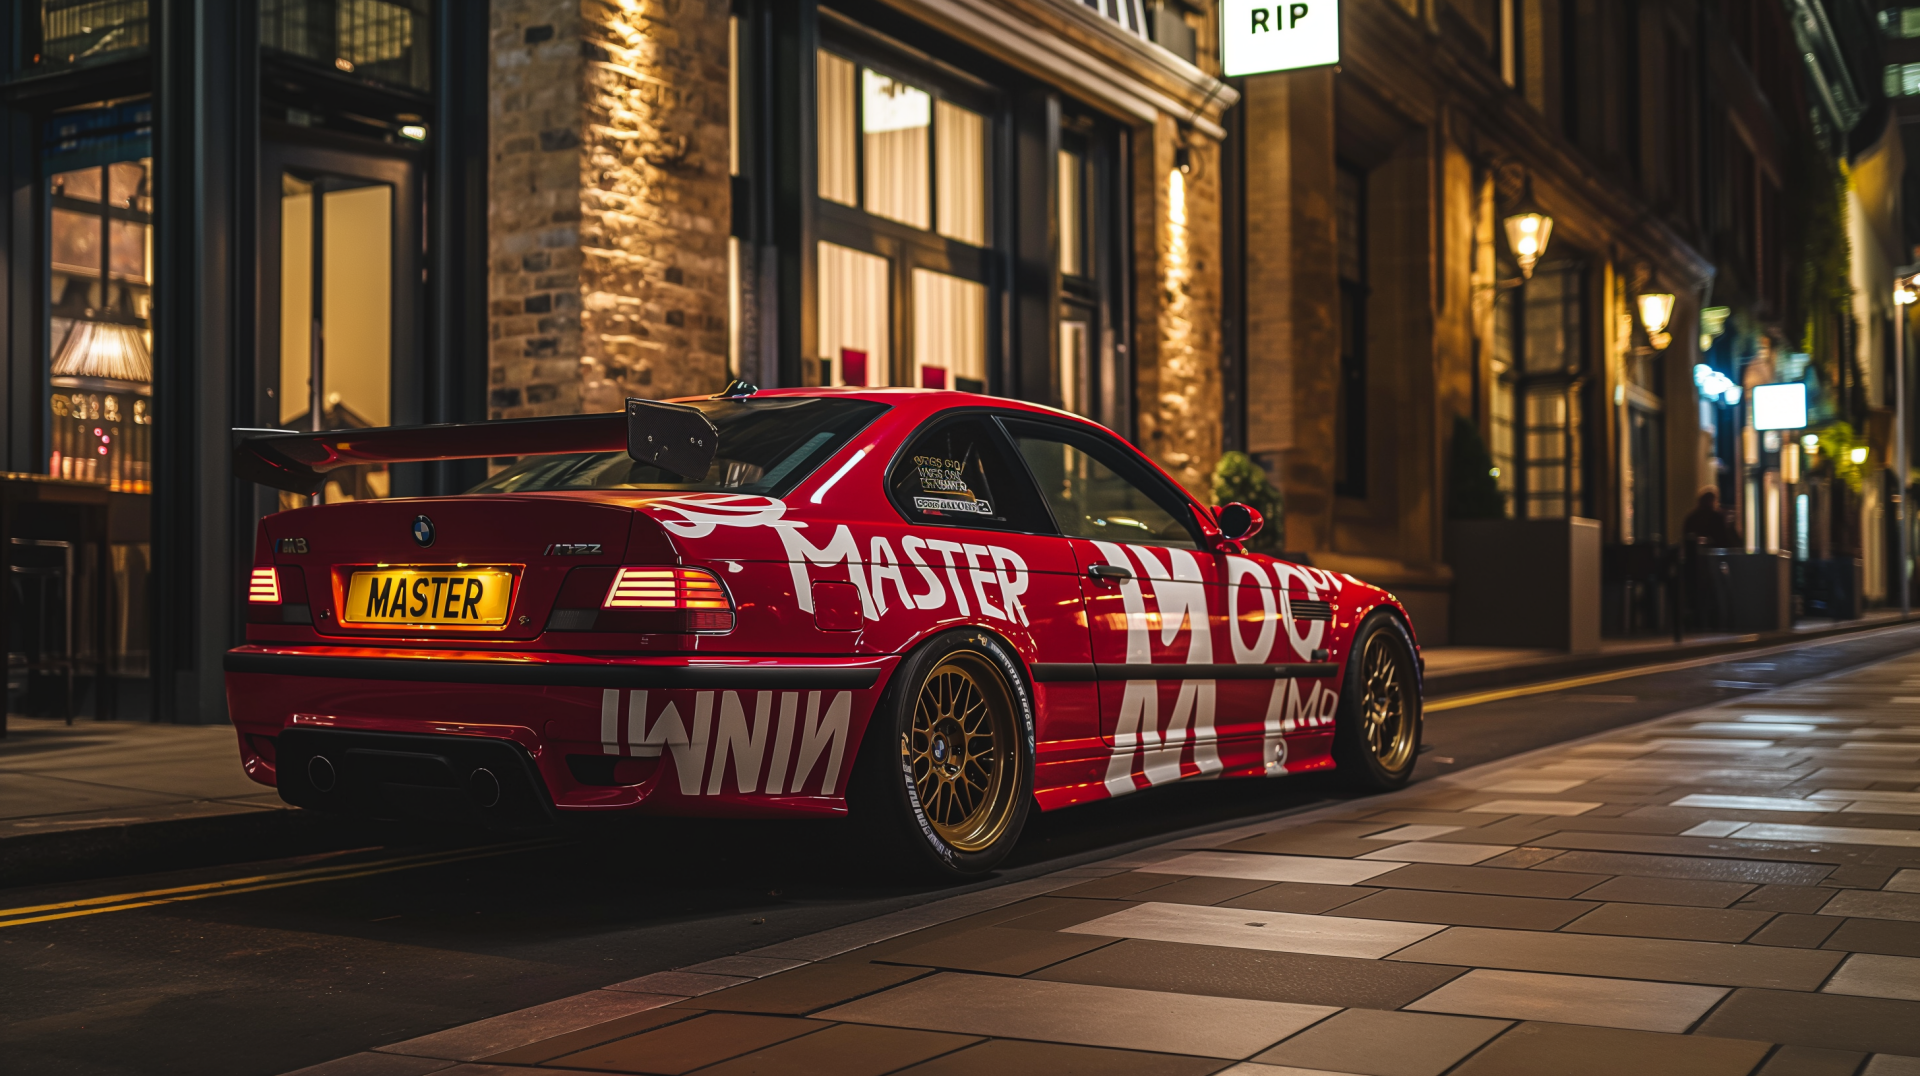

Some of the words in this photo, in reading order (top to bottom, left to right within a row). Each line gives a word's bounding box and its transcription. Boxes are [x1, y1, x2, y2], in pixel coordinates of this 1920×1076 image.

[1251, 2, 1309, 35] RIP
[775, 523, 1031, 628] MASTER
[365, 577, 484, 620] MASTER
